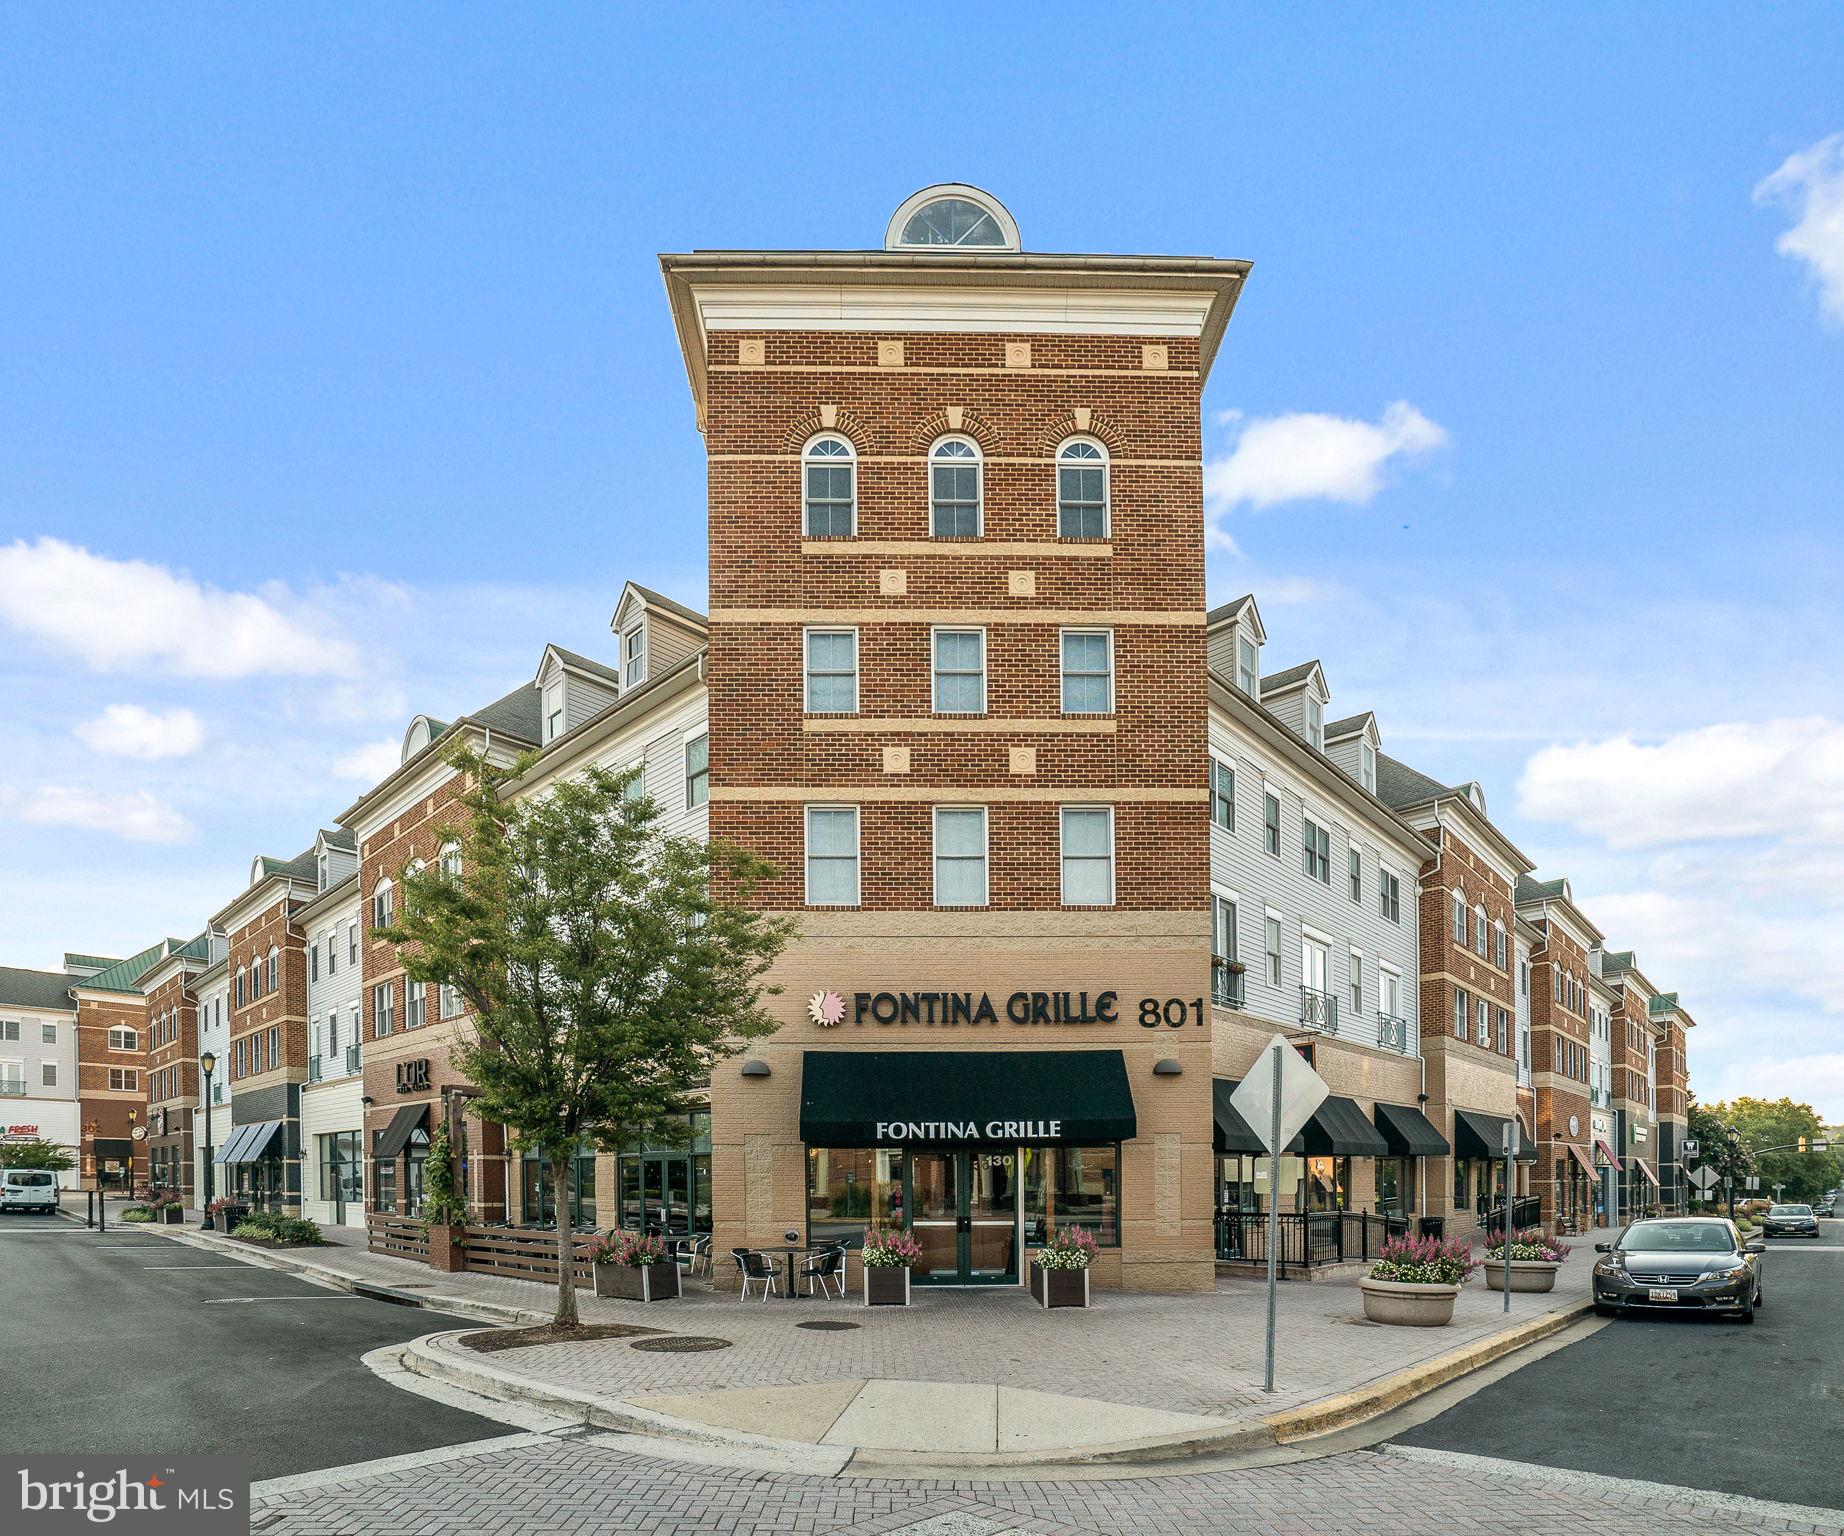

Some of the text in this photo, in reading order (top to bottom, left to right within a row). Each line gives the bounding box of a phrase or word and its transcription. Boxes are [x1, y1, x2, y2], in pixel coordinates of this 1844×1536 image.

[854, 990, 1119, 1025] FONTINA GRILLE
[1138, 997, 1205, 1029] 801
[8, 1124, 39, 1134] FRESH
[876, 1120, 1062, 1140] FONTINA GRILLE
[986, 1155, 1012, 1167] 130
